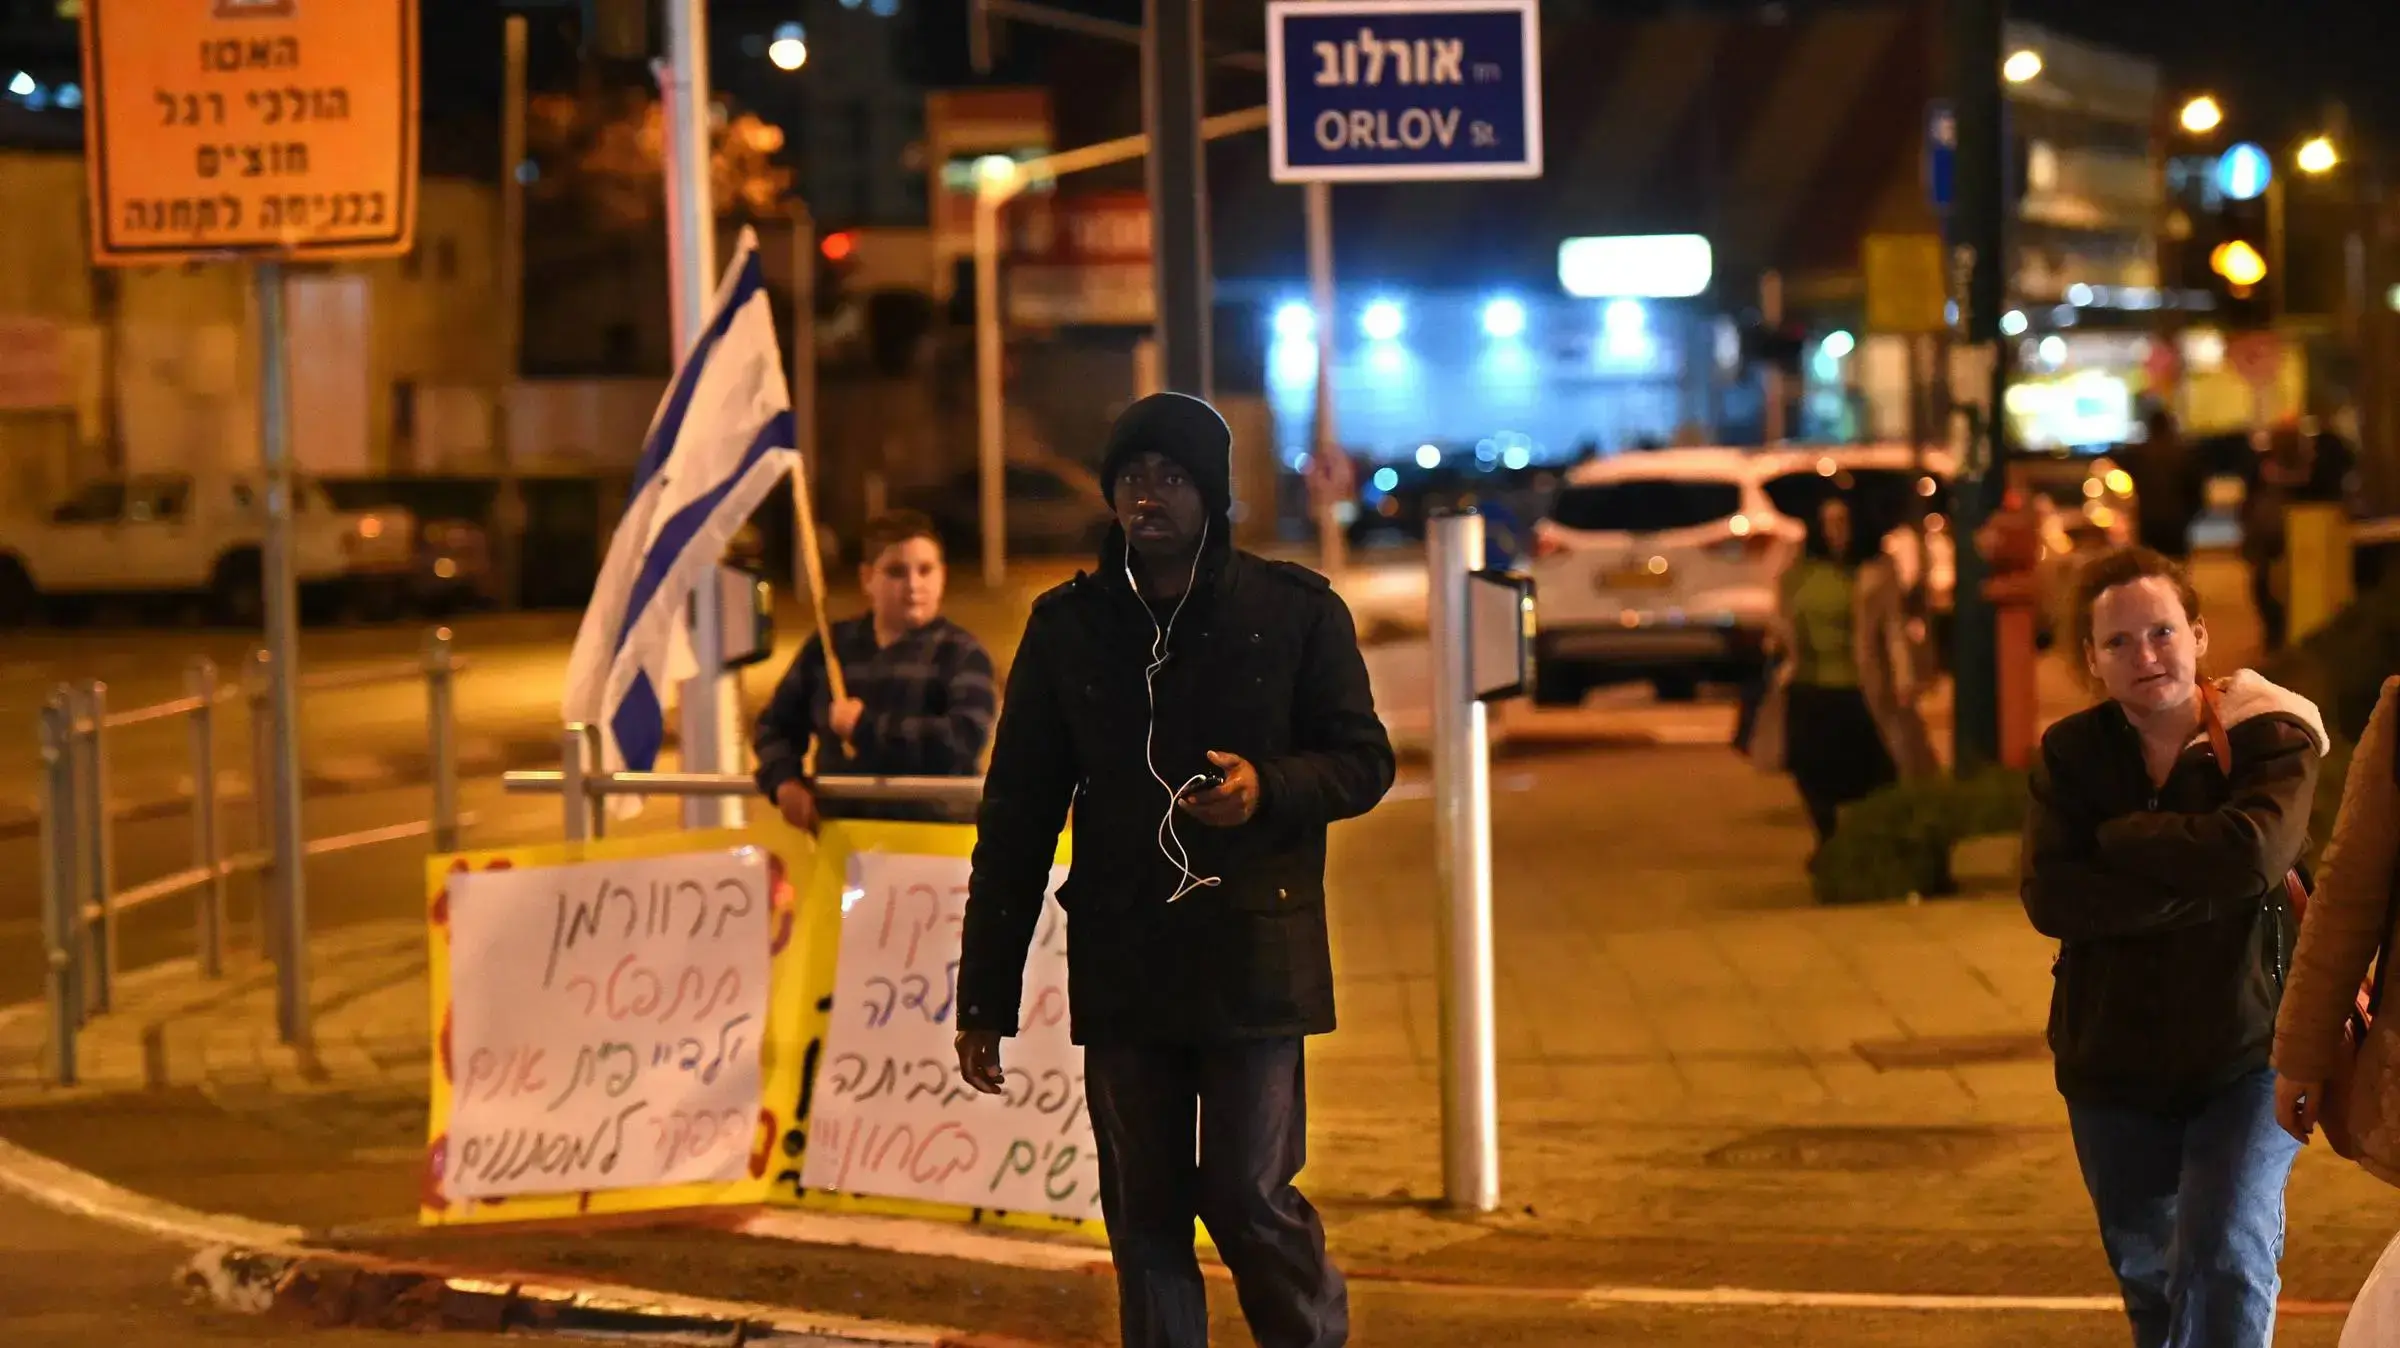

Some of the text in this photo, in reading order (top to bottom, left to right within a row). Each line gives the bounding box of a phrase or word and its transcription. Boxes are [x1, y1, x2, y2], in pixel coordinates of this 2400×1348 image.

[1313, 27, 1463, 86] אורלוב
[153, 87, 348, 127] הולכי רגל
[1314, 107, 1461, 150] ORLOV
[196, 142, 308, 178] חוצים
[565, 953, 742, 1023] תתפטר
